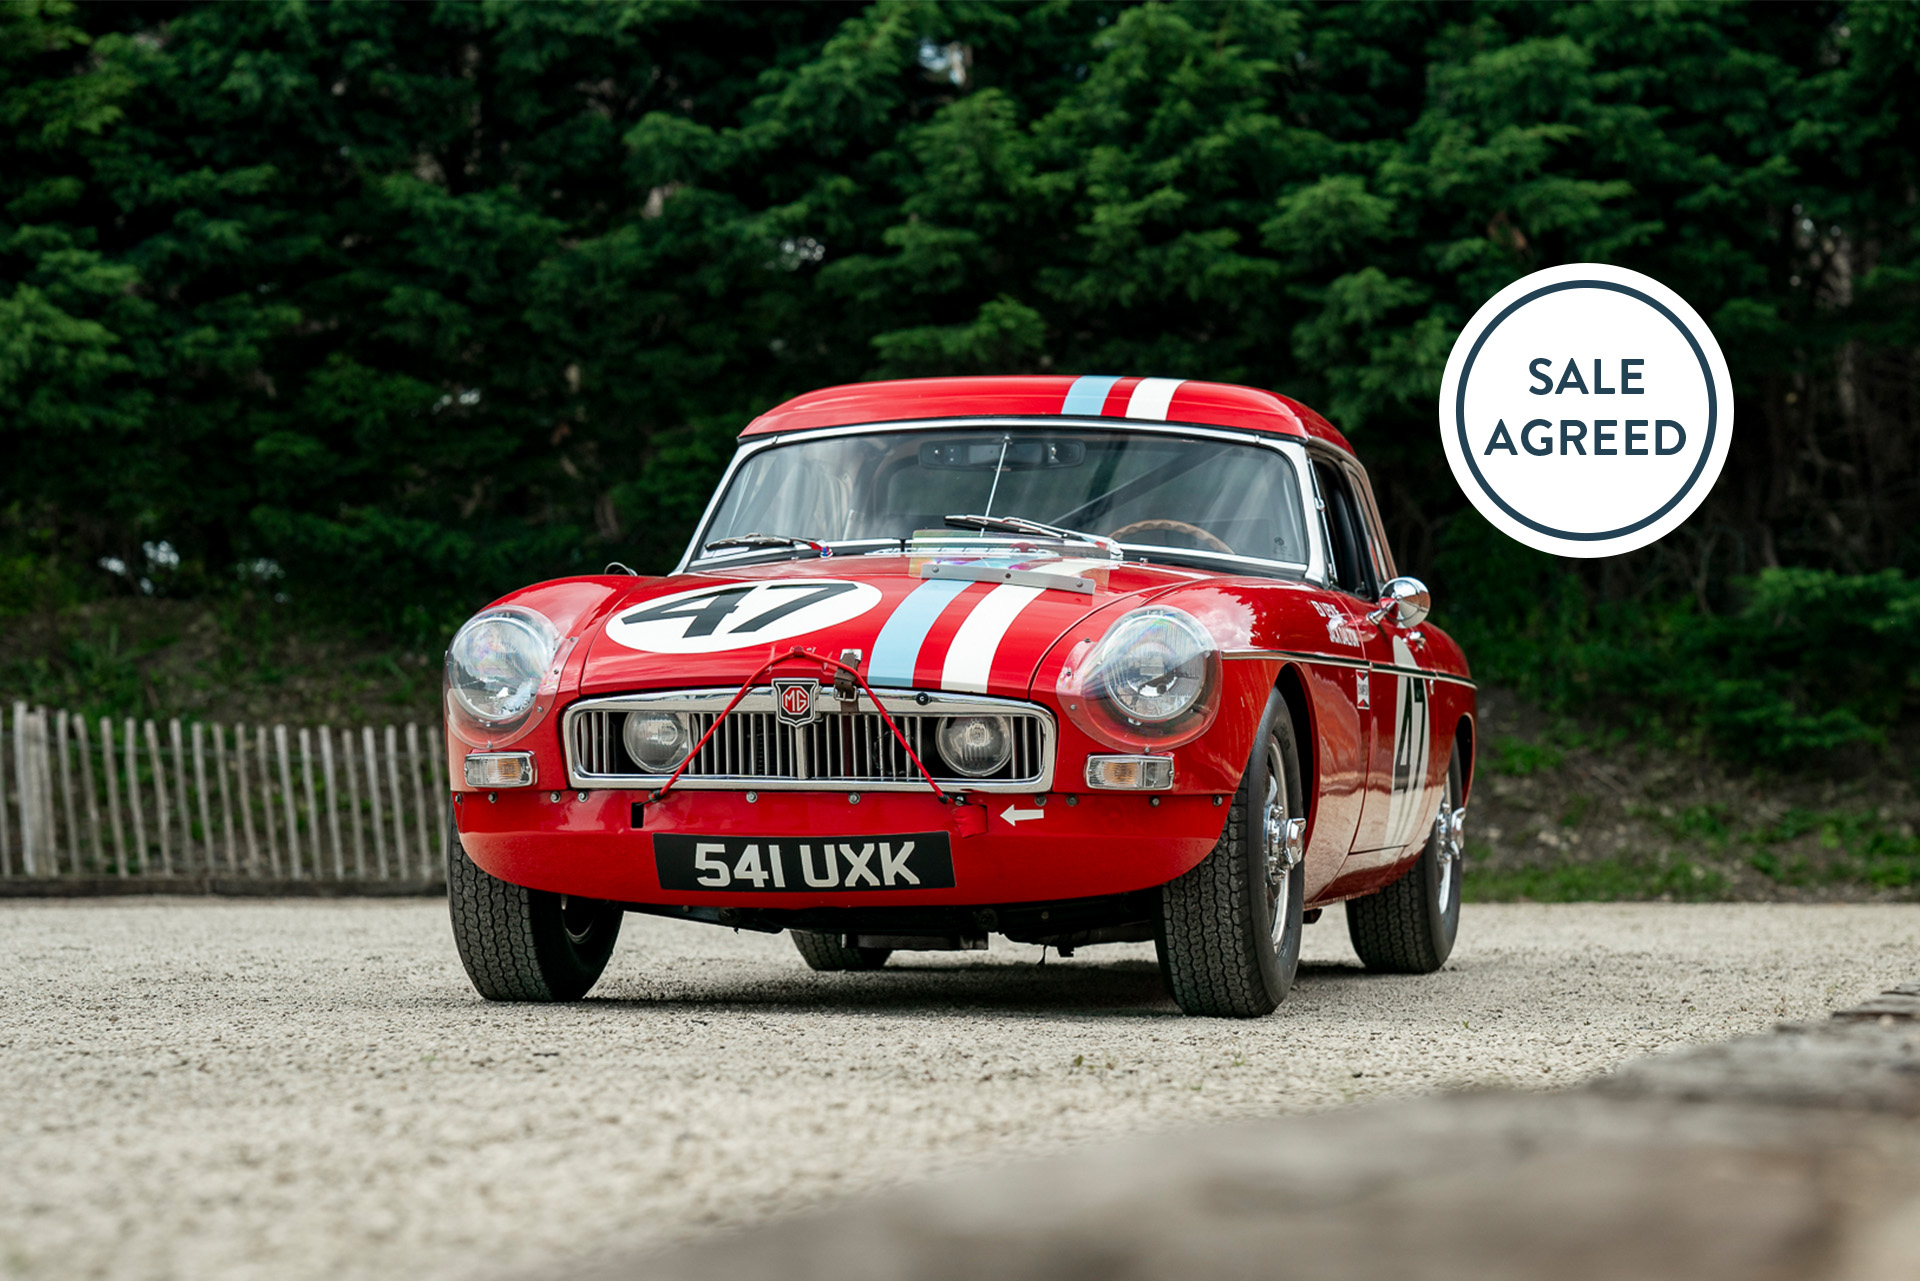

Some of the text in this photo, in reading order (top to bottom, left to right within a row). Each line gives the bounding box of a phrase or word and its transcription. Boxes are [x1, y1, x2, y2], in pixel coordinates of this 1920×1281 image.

[620, 582, 858, 638] 47
[785, 689, 807, 712] MG
[1393, 676, 1426, 800] 47
[694, 840, 921, 888] 541 UXK
